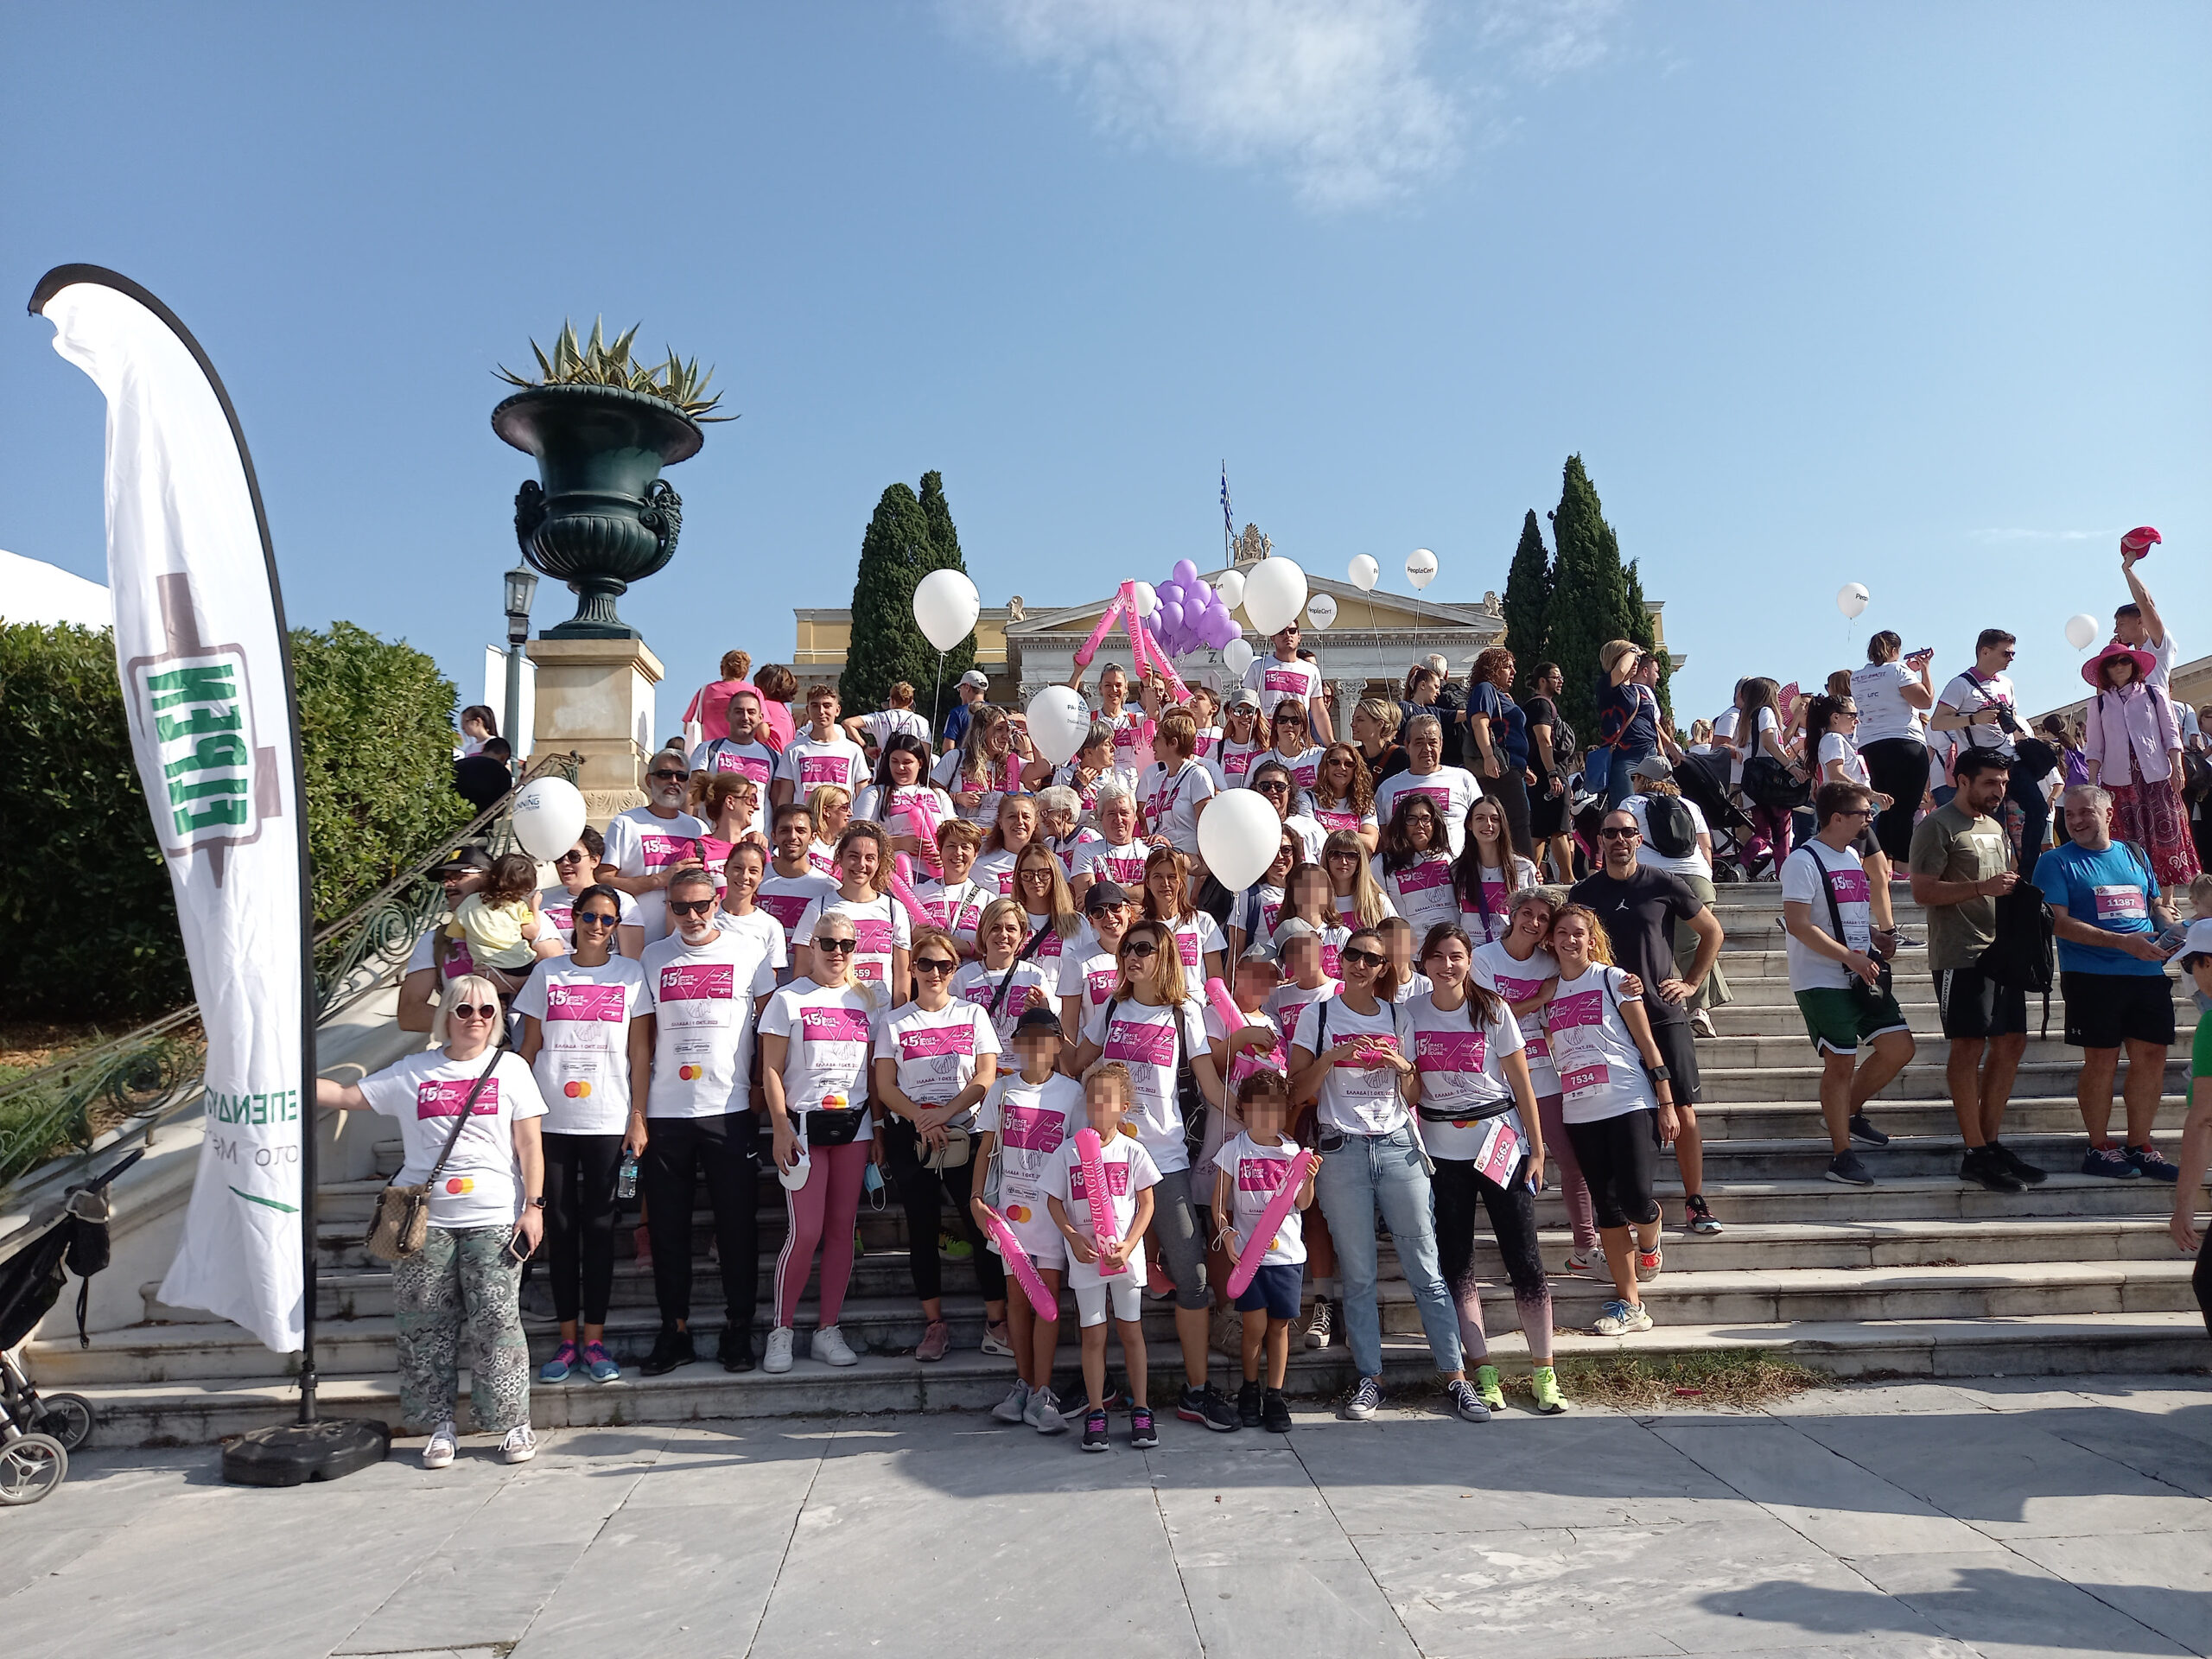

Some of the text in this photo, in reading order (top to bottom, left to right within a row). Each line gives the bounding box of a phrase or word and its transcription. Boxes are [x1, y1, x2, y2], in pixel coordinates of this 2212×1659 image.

[1128, 614, 1142, 662] STRONGER
[1266, 674, 1276, 683] 15
[720, 757, 733, 768] 15
[643, 840, 658, 854] 15
[1832, 877, 1844, 891] 15
[661, 973, 678, 988] 15
[1090, 976, 1106, 991] 15
[548, 990, 567, 1006] 15
[966, 992, 982, 1003] 15
[802, 1012, 821, 1026] 15
[901, 1035, 919, 1046] 15
[1109, 1027, 1122, 1043] 15
[1417, 1039, 1427, 1056] 15
[1571, 1073, 1594, 1085] 7534
[419, 1086, 438, 1103] 15
[1493, 1141, 1510, 1167] 7562
[1071, 1172, 1084, 1186] 15
[1095, 1157, 1109, 1206] TOGETHER
[1082, 1160, 1106, 1232] STRONGER
[1012, 1237, 1046, 1287] new balance
